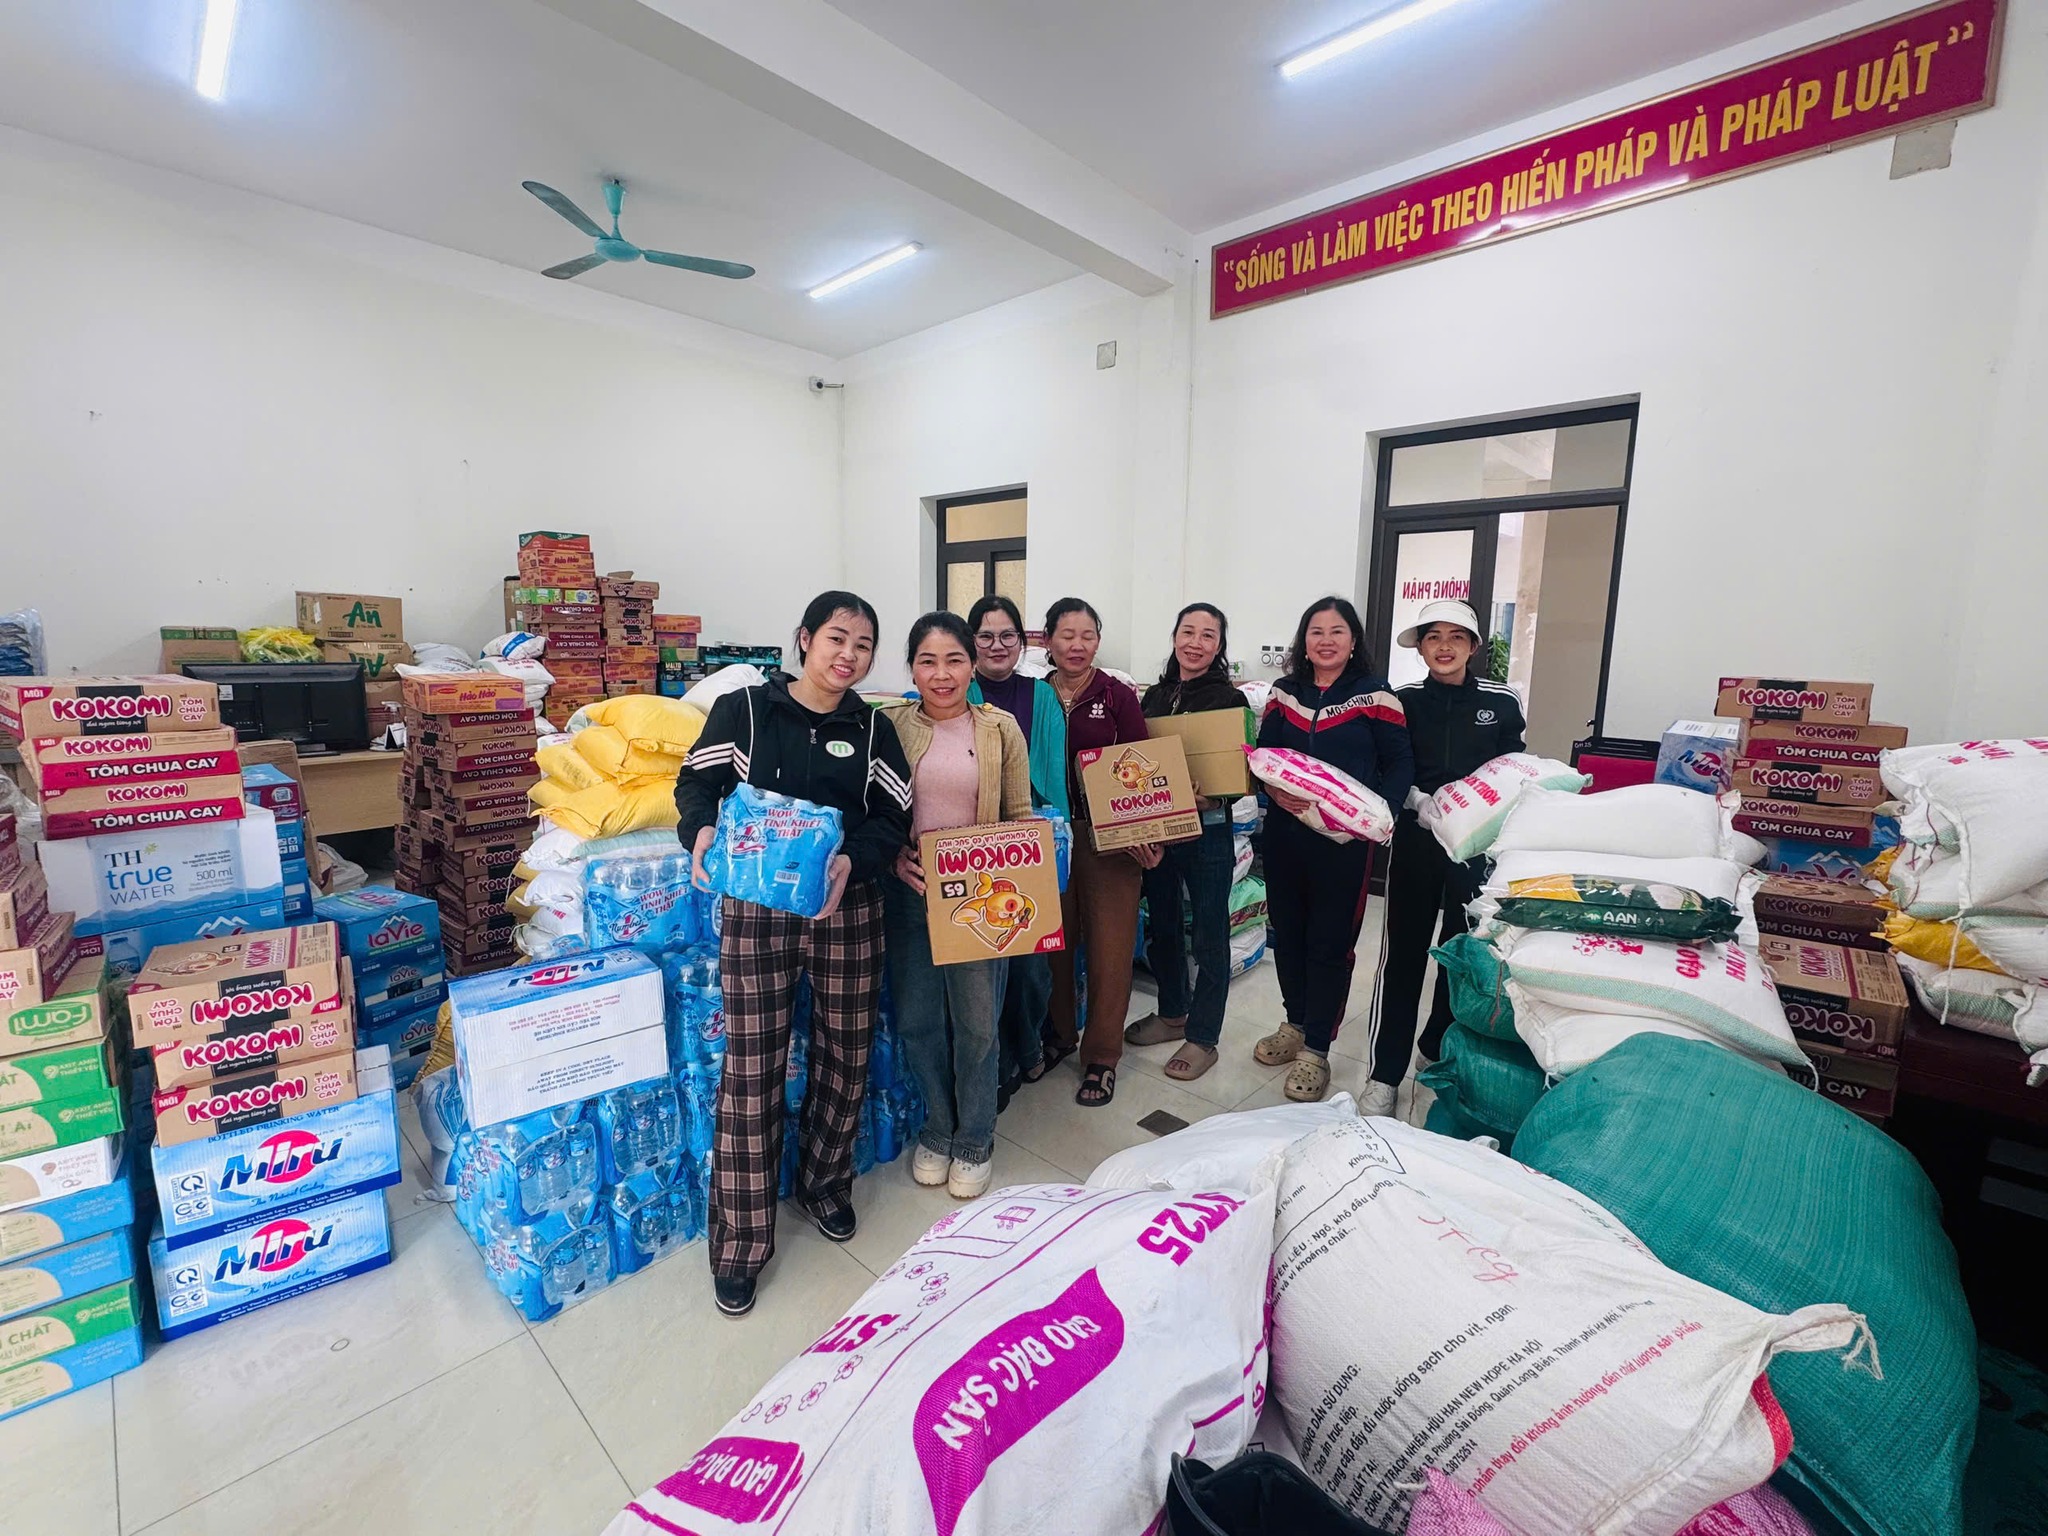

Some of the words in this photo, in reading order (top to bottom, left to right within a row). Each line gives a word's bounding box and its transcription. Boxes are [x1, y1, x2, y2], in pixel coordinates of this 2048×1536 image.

[1291, 234, 1317, 277] VÀ
[1322, 218, 1367, 266] LÀM
[1374, 201, 1425, 254] VIỆC
[1430, 181, 1493, 231] THEO
[1500, 147, 1567, 215] HIẾN
[1573, 127, 1657, 195] PHÁP
[1667, 103, 1710, 163] VÀ
[1719, 79, 1819, 153] PHÁP
[343, 601, 382, 628] An
[180, 697, 203, 707] TÔM
[460, 690, 476, 702] Hảo
[478, 688, 496, 699] Hảo
[1736, 688, 1828, 709] KOKOMI
[1835, 695, 1855, 704] TÔM
[51, 694, 172, 721] KOKOMI
[178, 706, 207, 715] CHUA
[1326, 694, 1375, 718] MOSCHINO
[183, 713, 203, 722] CAY
[460, 715, 477, 723] CAY
[478, 714, 500, 722] CHUA
[1834, 710, 1852, 718] CAY
[493, 724, 526, 735] KOKOMI
[1795, 726, 1859, 741] KOKOMI
[64, 735, 151, 757] KOKOMI
[482, 741, 515, 751] KOKOMI
[475, 757, 492, 765] TÔM
[514, 752, 529, 760] CAY
[1776, 746, 1808, 757] TÔM
[1809, 748, 1849, 761] CHUA
[1851, 751, 1880, 763] CAY
[86, 763, 129, 780] TÔM
[131, 760, 183, 776] CHUA
[185, 756, 220, 770] CAY
[481, 769, 504, 777] CHUA
[480, 780, 514, 792] KOKOMI
[1153, 777, 1166, 787] 65
[1751, 769, 1842, 793] KOKOMI
[1852, 778, 1872, 787] TÔM
[106, 783, 188, 803] KOKOMI
[1472, 779, 1502, 807] THƠM
[1851, 791, 1870, 800] CAY
[476, 800, 493, 808] CAY
[494, 797, 515, 805] CHUA
[1110, 790, 1172, 812] KOKOMI
[1740, 800, 1799, 816] KOKOMI
[91, 813, 133, 830] TÔM
[136, 809, 187, 825] CHUA
[189, 805, 224, 819] CAY
[492, 807, 526, 819] KOKOMI
[767, 807, 800, 818] WOW!
[763, 818, 787, 828] TINH
[790, 817, 824, 828] KHIẾT
[1750, 820, 1780, 833] TÔM
[1782, 823, 1822, 837] CHUA
[1825, 829, 1853, 840] CAY
[480, 833, 514, 845] KOKOMI
[777, 828, 803, 839] THẬT
[997, 832, 1026, 842] KOKOMI
[937, 840, 952, 849] HÚT
[104, 850, 143, 869] TH
[937, 841, 1041, 875] KOKOMI
[105, 865, 173, 891] true
[196, 869, 216, 882] 500
[218, 867, 233, 877] ml
[110, 884, 175, 906] WATER
[943, 882, 965, 897] 65
[1764, 897, 1833, 919] KOKOMI
[1603, 911, 1637, 924] AAN
[1781, 923, 1823, 939] CHUA
[1827, 930, 1860, 943] CAY
[1676, 948, 1706, 979] GẠO
[152, 999, 177, 1009] CAY
[193, 983, 314, 1024] KOKOMI
[150, 1008, 183, 1019] CHUA
[153, 1017, 181, 1028] TÔM
[312, 1022, 335, 1032] TÔM
[310, 1030, 339, 1041] CHUA
[314, 1038, 336, 1048] CAY
[183, 1025, 302, 1069] KOKOMI
[316, 1073, 340, 1084] TÔM
[313, 1081, 342, 1092] CHUA
[318, 1089, 340, 1099] CAY
[1826, 1081, 1868, 1100] CAY
[186, 1077, 307, 1123] KOKOMI
[207, 1127, 254, 1144] BOTTLED
[256, 1115, 304, 1133] DRINKING
[305, 1105, 340, 1120] WATER
[217, 1136, 345, 1193] Miru
[1292, 1184, 1306, 1199] min
[212, 1224, 335, 1283] Miru
[1296, 1243, 1329, 1272] khoáng
[1057, 1314, 1102, 1353] GẠO
[996, 1333, 1056, 1391] ĐẶC
[1489, 1380, 1516, 1404] Quận
[1514, 1366, 1540, 1390] Long
[1554, 1335, 1582, 1358] Thành
[1340, 1448, 1355, 1469] cấp
[1363, 1414, 1378, 1434] đủ
[1392, 1374, 1422, 1398] uống
[1418, 1349, 1445, 1374] sạch
[1444, 1333, 1467, 1354] cho
[1466, 1321, 1487, 1339] vịt,
[932, 1374, 996, 1451] SẢN
[1364, 1489, 1384, 1518] CÔNG
[1385, 1456, 1411, 1484] TRÁCH
[1441, 1396, 1465, 1418] HẠN
[1461, 1377, 1485, 1403] NEW
[1480, 1360, 1509, 1386] HOPE
[1523, 1338, 1545, 1357] NỘI
[1473, 1466, 1496, 1494] phẩm
[1492, 1448, 1517, 1471] thay
[1509, 1434, 1529, 1454] đổi
[1525, 1415, 1560, 1444] không
[1602, 1369, 1623, 1389] đến
[694, 1447, 741, 1487] ĐẶC
[730, 1455, 779, 1497] GẠO
